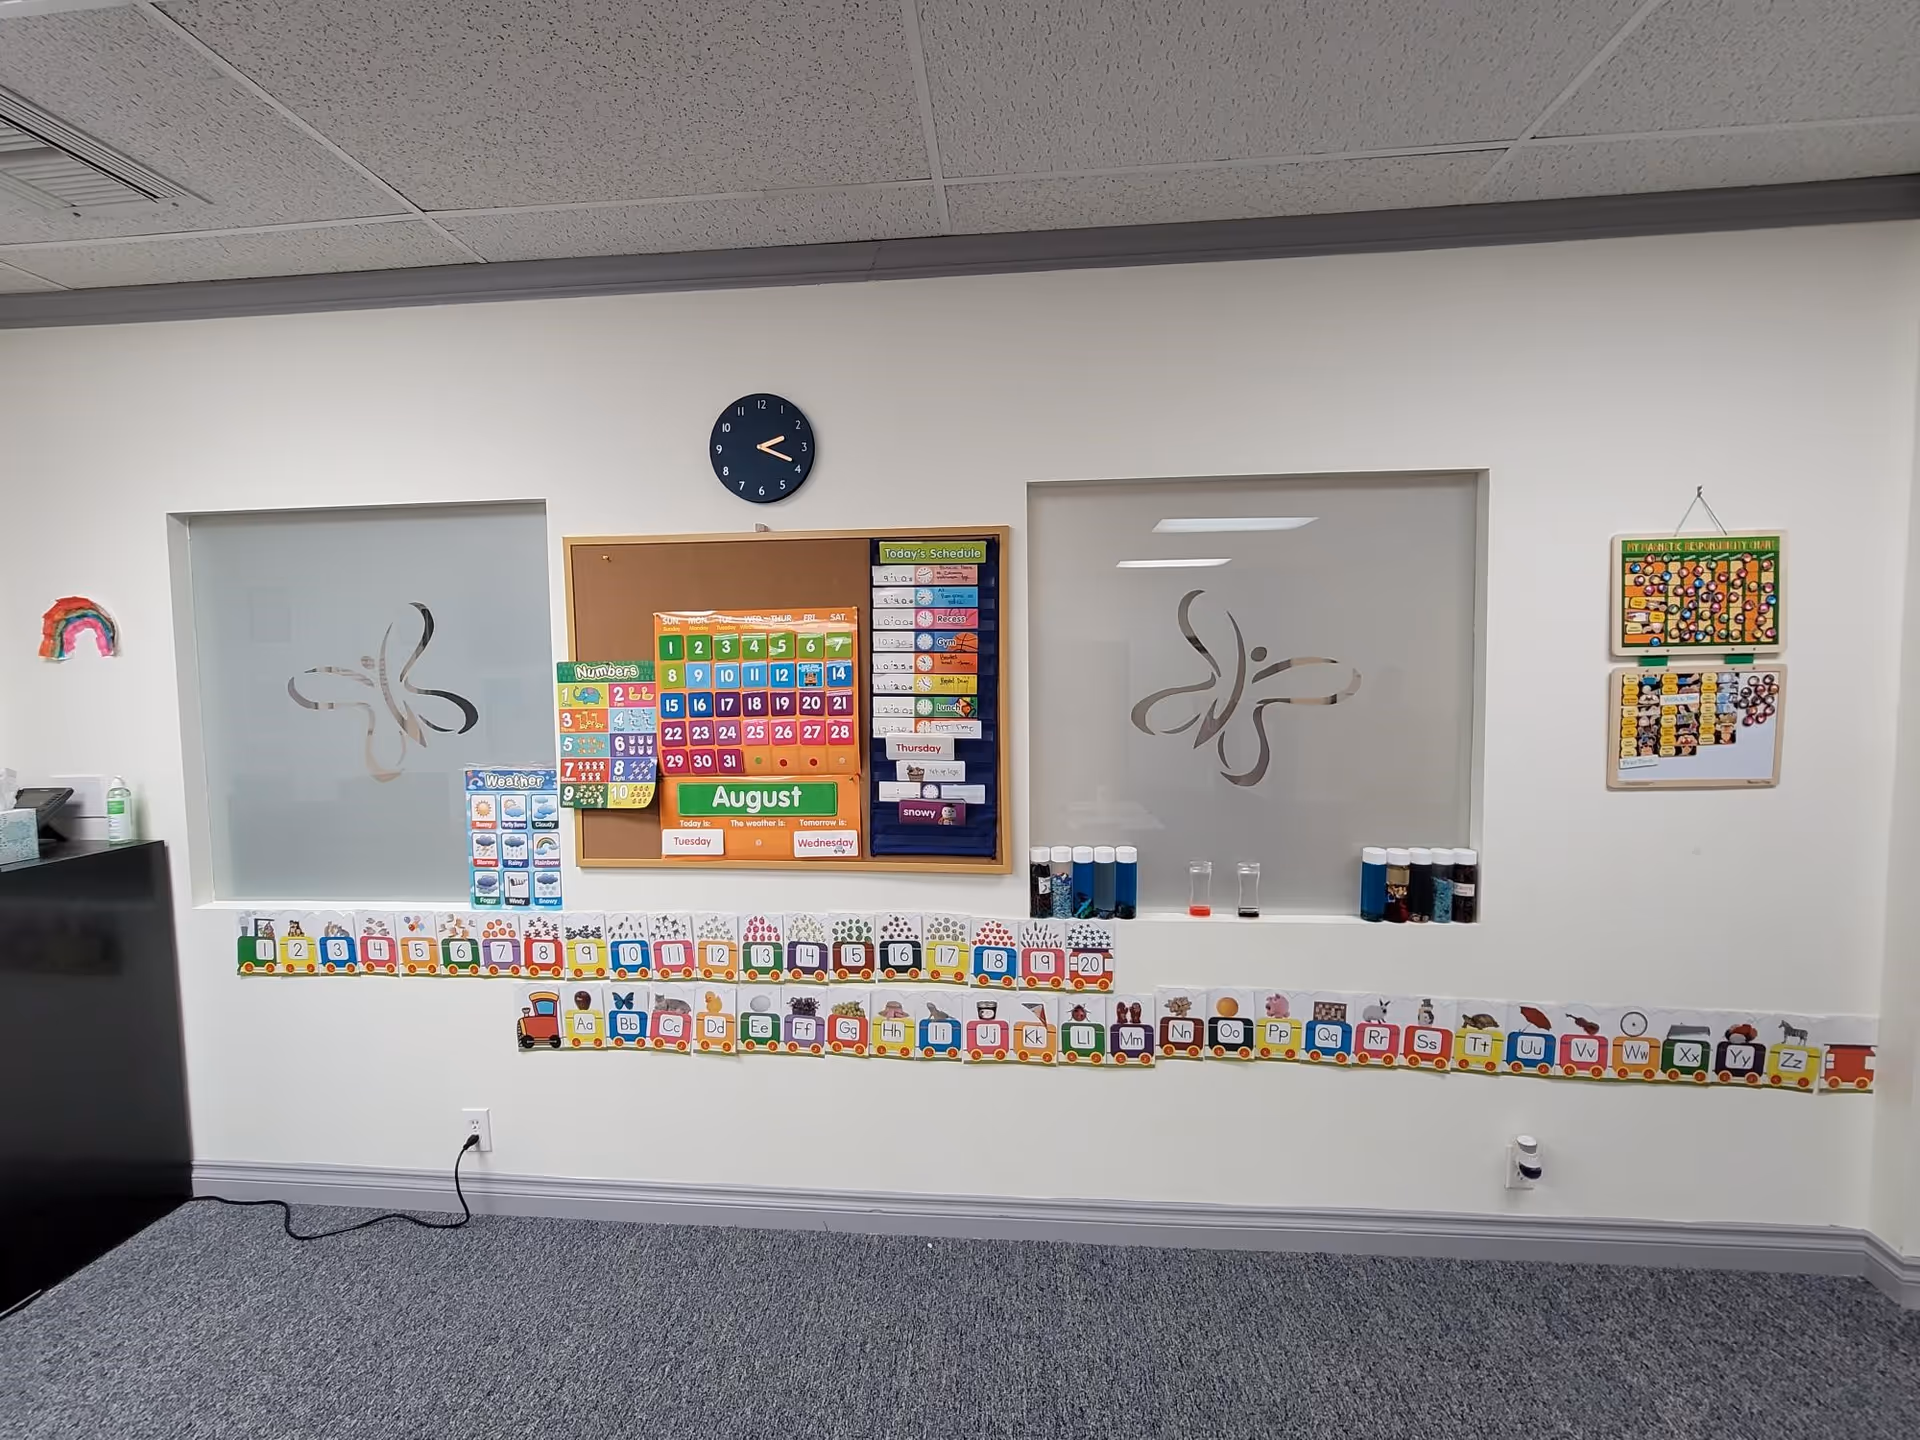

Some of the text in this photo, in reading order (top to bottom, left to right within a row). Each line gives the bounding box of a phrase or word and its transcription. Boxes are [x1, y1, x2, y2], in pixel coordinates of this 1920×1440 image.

[758, 400, 766, 409] 12
[738, 406, 744, 416] 11
[722, 423, 730, 432] 10
[796, 420, 801, 430] 2
[716, 445, 722, 454] 9
[801, 442, 807, 452] 3
[723, 466, 729, 475] 8
[794, 465, 801, 473] 4
[739, 481, 745, 490] 7
[759, 486, 765, 495] 6
[780, 480, 785, 490] 5
[885, 548, 980, 560] Today's Schedule
[668, 639, 843, 654] 1 2 3 4 5 6 7
[937, 637, 956, 646] Gym
[576, 665, 638, 679] Numbers
[668, 669, 677, 682] 8
[694, 669, 703, 682] 9
[720, 669, 734, 682] 10
[750, 668, 759, 681] 11
[776, 668, 789, 681] 12
[832, 667, 846, 680] 14
[562, 687, 624, 702] 1 2
[666, 697, 846, 712] 15 16 17 18 19 20 21
[562, 712, 624, 727] 3 4
[664, 726, 849, 740] 22 23 24 25 26 27 28
[563, 736, 625, 751] 5 6
[896, 744, 941, 754] Thursday
[666, 755, 736, 768] 29 30 31
[564, 760, 624, 777] 7 8
[486, 774, 543, 787] Weather
[563, 785, 628, 800] 9 10
[712, 786, 802, 814] August
[903, 808, 935, 818] snowy
[673, 836, 712, 847] Tuesday
[798, 839, 854, 848] Wednesday
[293, 942, 303, 957] 2
[333, 942, 342, 957] 3
[373, 942, 383, 956] 4
[415, 943, 423, 957] 5
[456, 944, 465, 959] 6
[497, 944, 505, 959] 7
[539, 945, 548, 960] 8
[582, 945, 592, 961] 9
[621, 946, 638, 962] 10
[666, 946, 681, 963] 11
[710, 947, 725, 963] 12
[754, 947, 771, 963] 13
[800, 948, 815, 964] 14
[844, 946, 862, 963] 15
[892, 946, 909, 962] 16
[938, 947, 955, 964] 17
[986, 952, 1004, 969] 18
[1034, 953, 1050, 971] 19
[1081, 956, 1099, 972] 20
[576, 1017, 1802, 1070] Aa Bb Cc Dd Ee Ff Gg Hh Ii Jj Kk Ll Mm Nn Oo Pp Qq Rr Ss Tt Uu Vv Ww Xx Yy Zz
